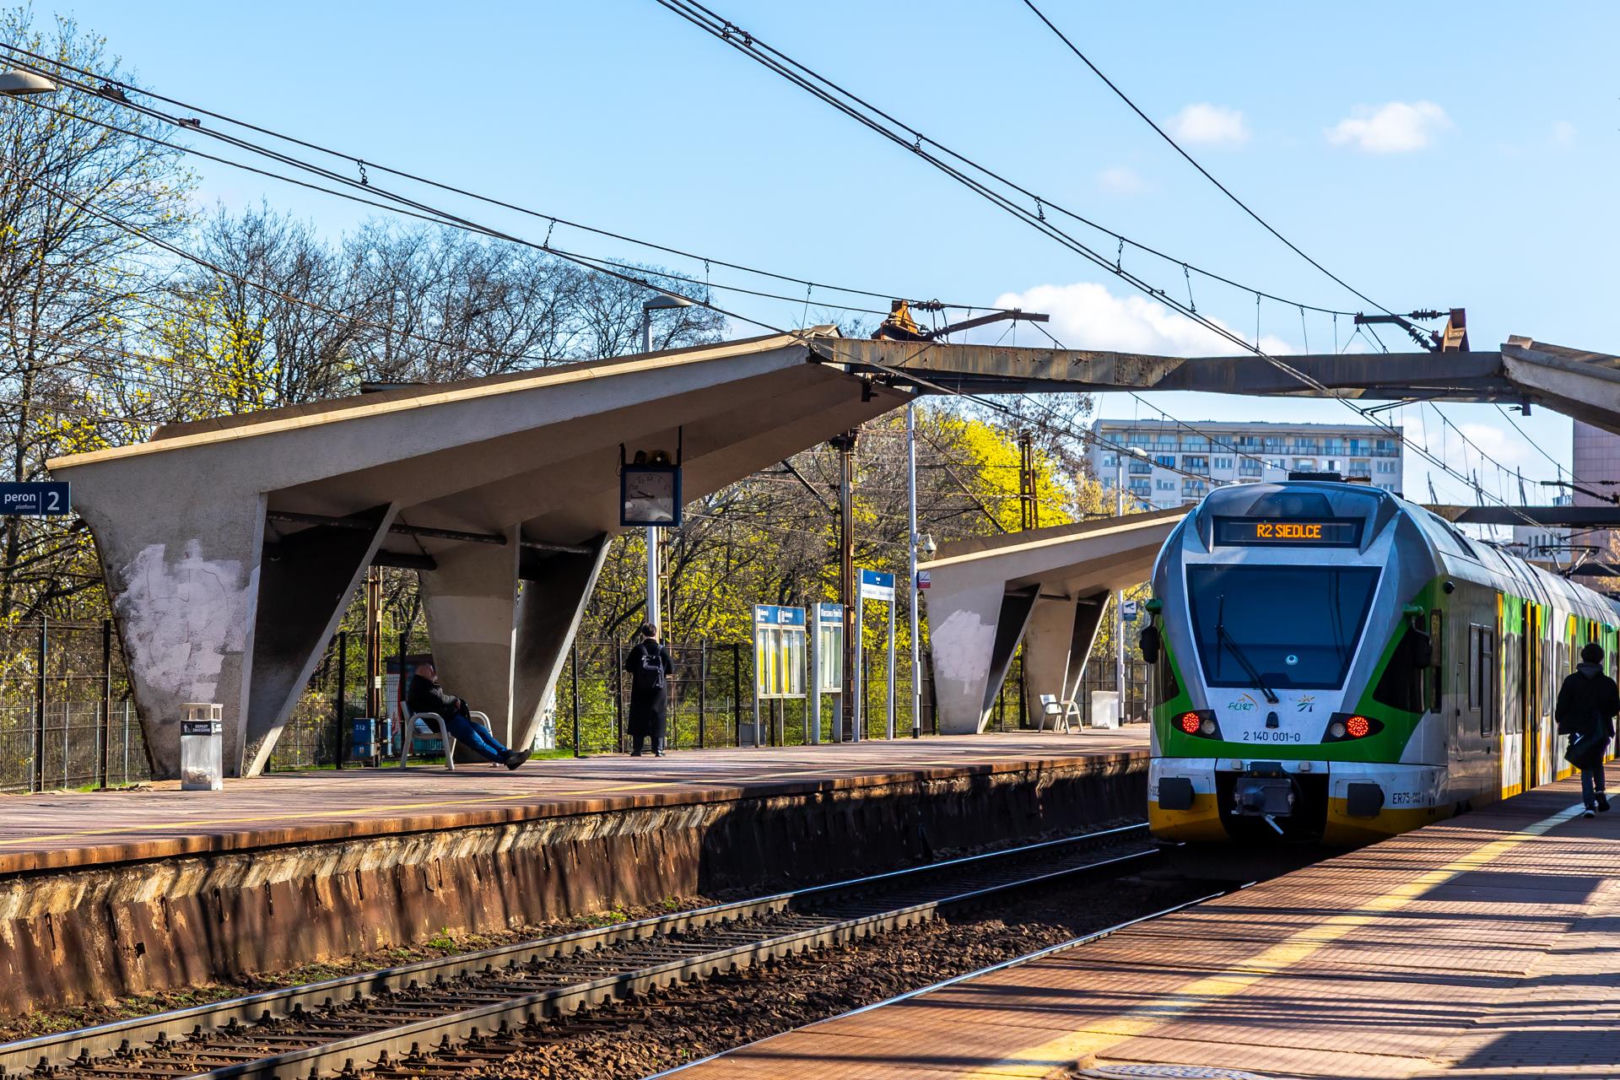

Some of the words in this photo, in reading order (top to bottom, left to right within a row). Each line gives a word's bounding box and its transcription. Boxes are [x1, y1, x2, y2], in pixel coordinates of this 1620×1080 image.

[4, 493, 36, 504] peron
[47, 491, 60, 511] 2
[1256, 524, 1272, 538] R2
[1275, 524, 1322, 539] SIEDLCE
[1243, 731, 1249, 741] 2
[1253, 731, 1268, 741] 140
[1272, 732, 1301, 742] 001-0
